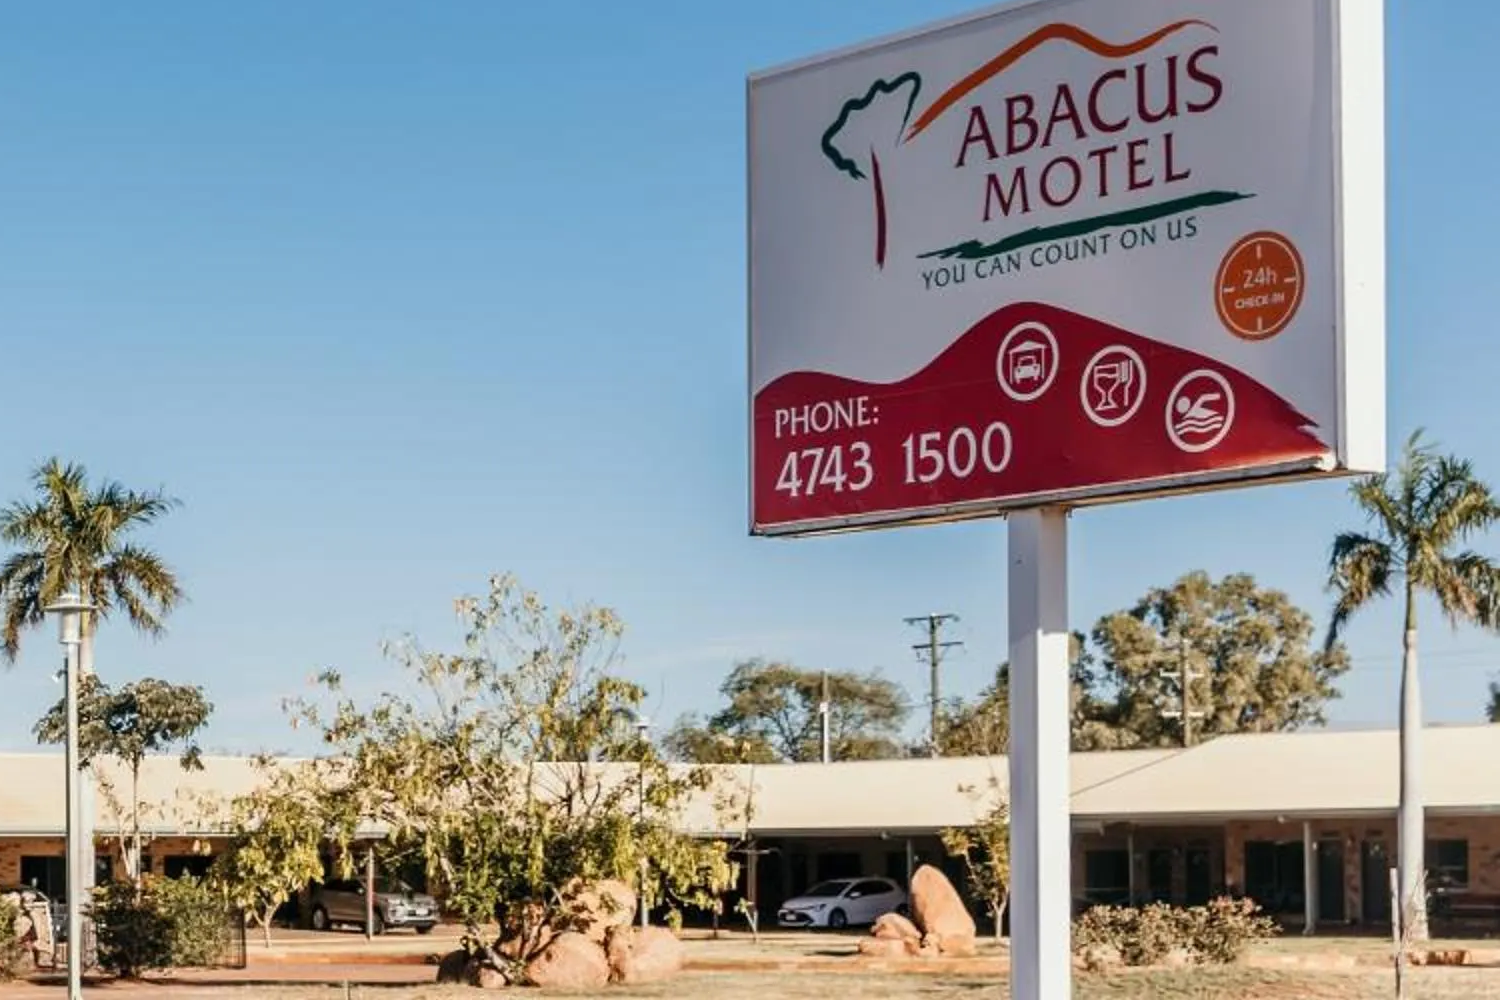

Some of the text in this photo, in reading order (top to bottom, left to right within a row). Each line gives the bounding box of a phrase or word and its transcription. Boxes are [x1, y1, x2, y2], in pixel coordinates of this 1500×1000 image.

[954, 45, 1223, 168] ABACUS
[981, 132, 1191, 223] MOTEL
[921, 215, 1198, 290] YOU CAN COUNT ON US
[1243, 266, 1278, 289] 24h
[774, 396, 880, 439] PHONE:
[774, 421, 1013, 497] 4743 1500
